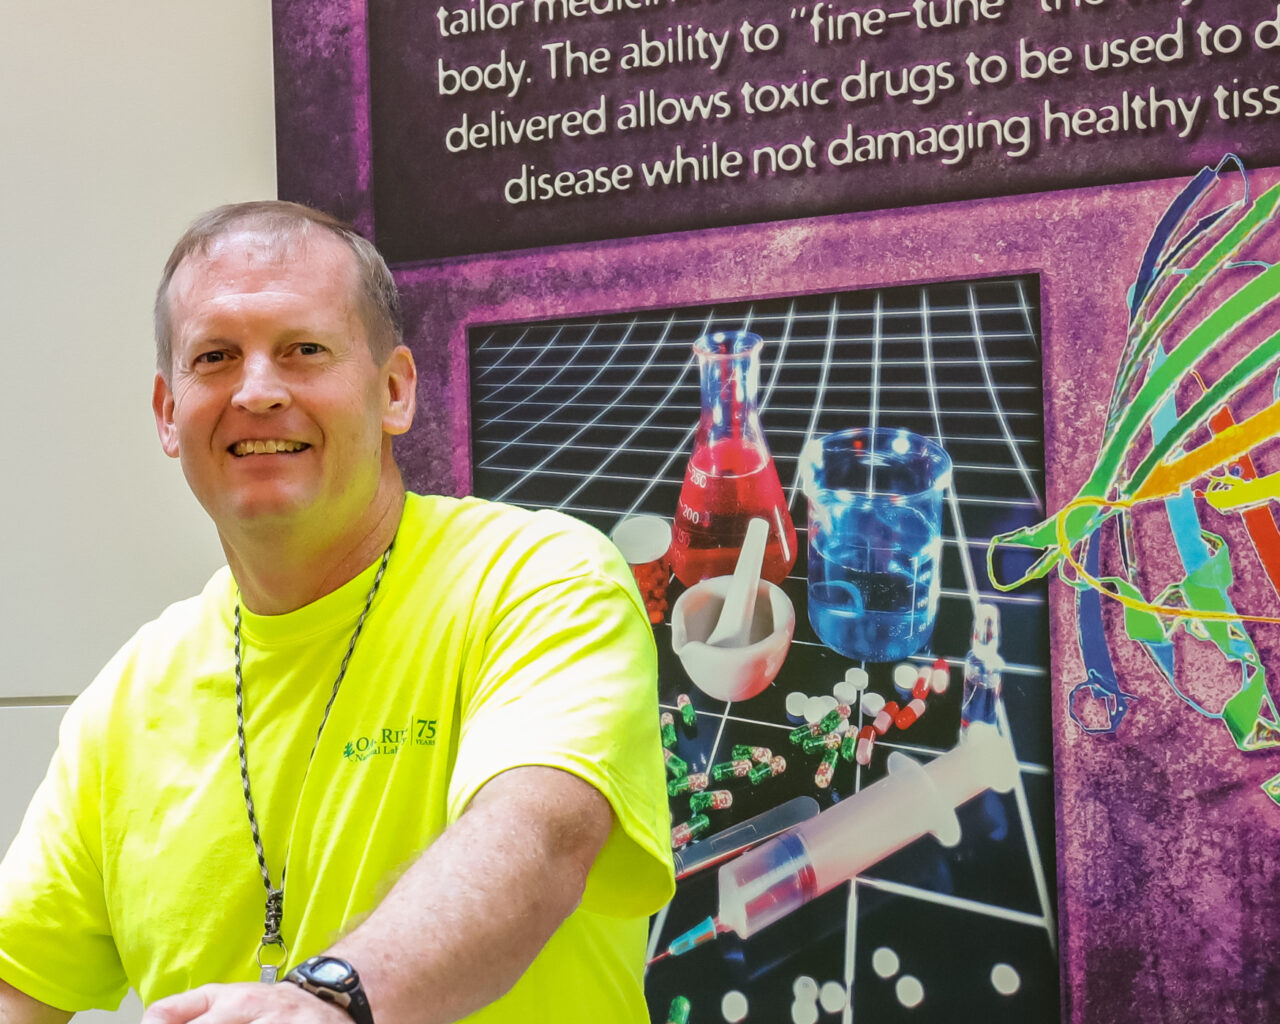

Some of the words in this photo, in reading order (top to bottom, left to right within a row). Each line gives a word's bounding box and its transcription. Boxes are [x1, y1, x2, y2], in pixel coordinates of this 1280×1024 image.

[436, 0, 521, 37] tailor
[438, 49, 532, 97] body.
[542, 40, 611, 79] The
[620, 25, 729, 70] ability
[740, 20, 780, 53] to
[445, 94, 606, 153] delivered
[617, 89, 732, 130] allows
[740, 70, 828, 115] toxic
[840, 60, 956, 105] drugs
[965, 51, 1008, 86] to
[1020, 38, 1073, 79] be
[1084, 17, 1184, 71] used
[1196, 20, 1243, 56] to
[505, 164, 634, 204] disease
[642, 141, 743, 188] while
[753, 135, 817, 175] not
[827, 111, 1031, 166] damaging
[1044, 86, 1202, 141] healthy
[682, 503, 700, 524] 200
[416, 718, 438, 739] 75
